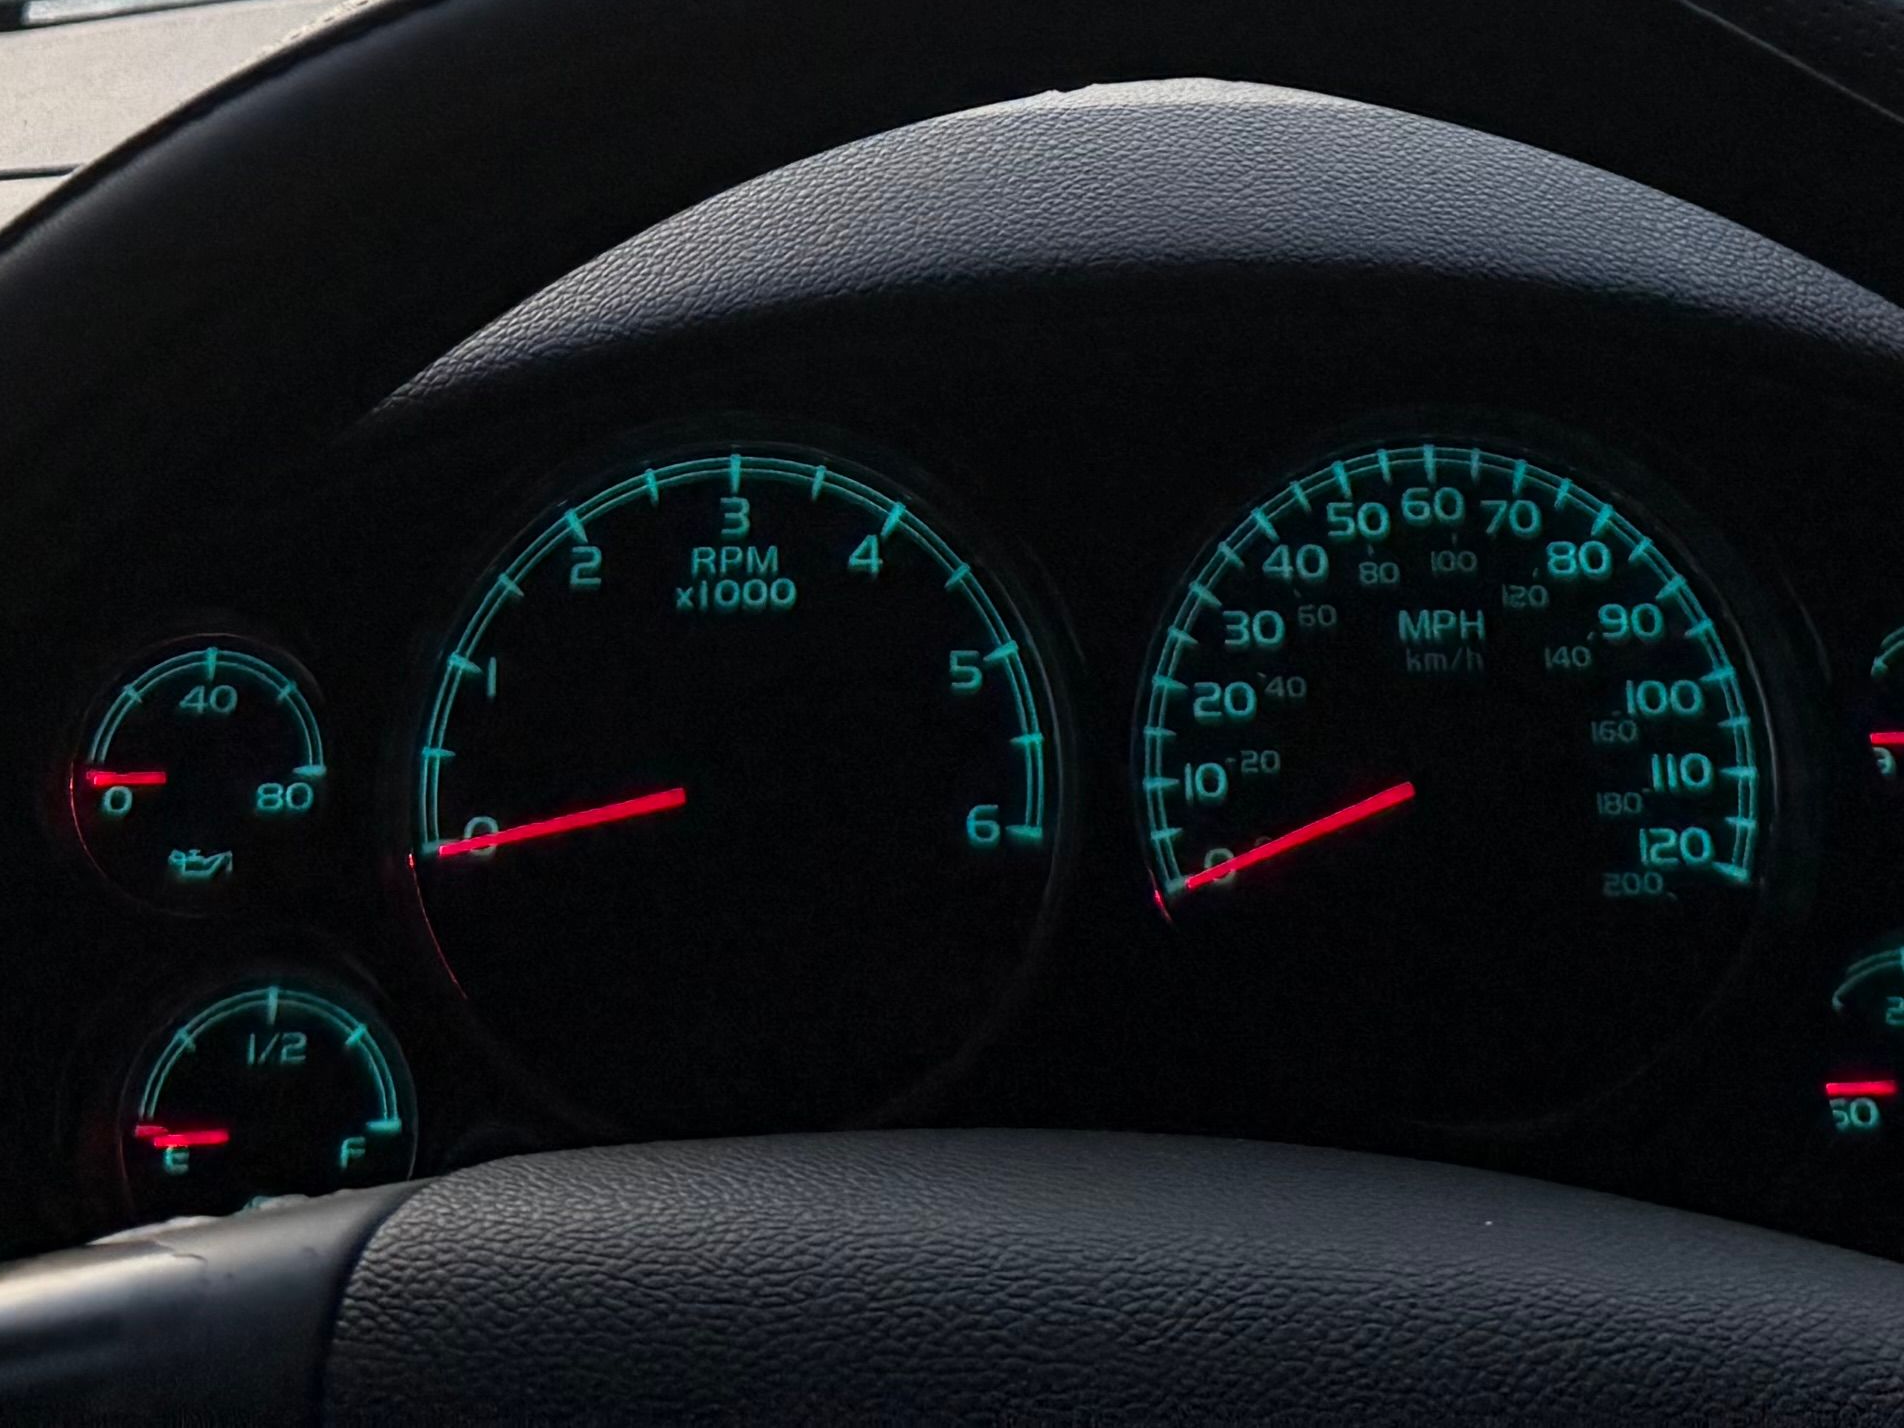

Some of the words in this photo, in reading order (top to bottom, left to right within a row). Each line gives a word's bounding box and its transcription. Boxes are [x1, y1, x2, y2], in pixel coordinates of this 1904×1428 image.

[720, 495, 750, 536] 3
[1326, 502, 1389, 537] 50
[1401, 486, 1464, 522] 60
[1481, 499, 1541, 535] 70
[570, 540, 602, 586] 2
[691, 545, 778, 576] RPM
[848, 531, 888, 574] 4
[1262, 543, 1329, 580] 40
[1430, 550, 1478, 573] 100
[1547, 540, 1611, 576] 80
[1358, 561, 1400, 585] 80
[677, 578, 797, 607] x1000
[1502, 584, 1549, 608] 120
[1223, 610, 1285, 646] 30
[1297, 604, 1337, 628] 60
[1398, 609, 1485, 641] MPH
[1598, 603, 1663, 639] 90
[950, 650, 983, 690] 5
[1405, 646, 1483, 672] km/h
[1544, 645, 1592, 668] 140
[179, 684, 238, 714] 40
[1193, 681, 1256, 719] 20
[1266, 676, 1307, 698] 40
[1626, 675, 1707, 715] 100
[1591, 719, 1638, 744] 160
[1241, 749, 1280, 774] 20
[1651, 753, 1712, 790] 110
[256, 782, 313, 811] 80
[1184, 762, 1227, 800] 10
[102, 785, 133, 815] 0
[1597, 792, 1643, 816] 180
[966, 804, 1000, 844] 6
[1639, 826, 1712, 864] 120
[1605, 869, 1664, 895] 200
[247, 1032, 307, 1064] 1/2
[339, 1137, 365, 1167] F
